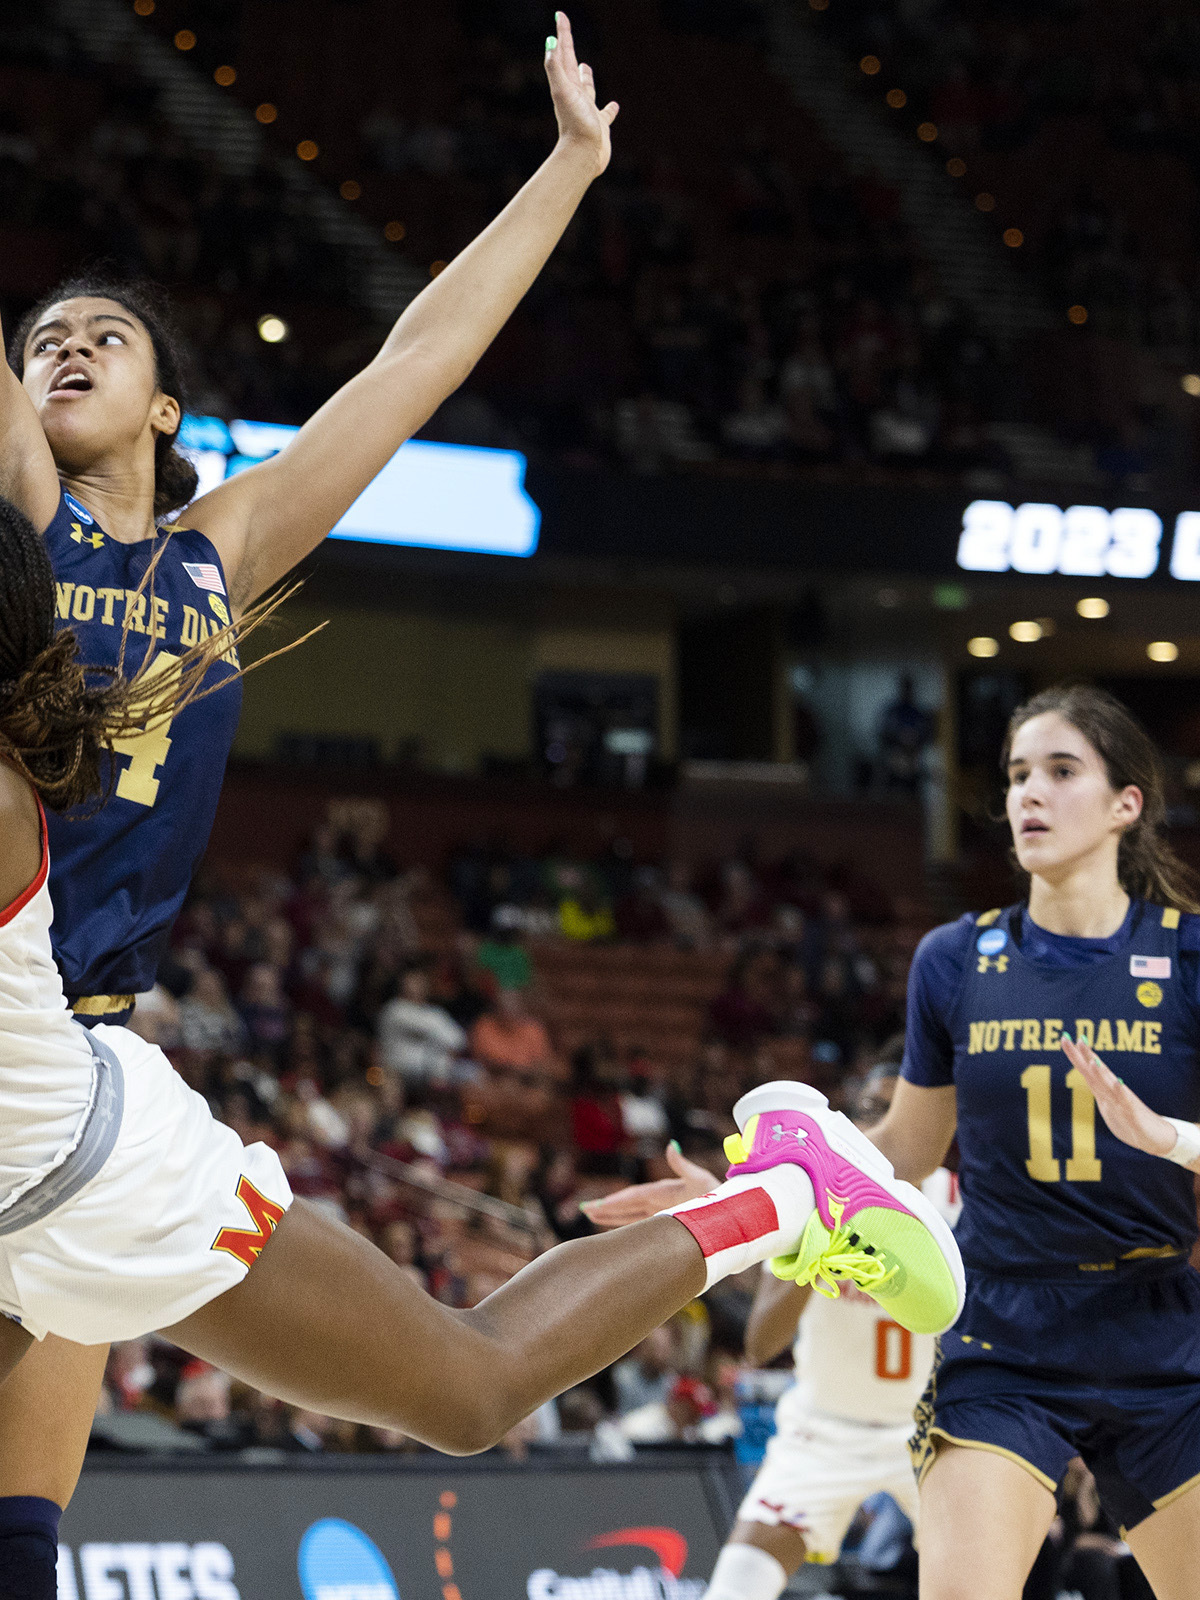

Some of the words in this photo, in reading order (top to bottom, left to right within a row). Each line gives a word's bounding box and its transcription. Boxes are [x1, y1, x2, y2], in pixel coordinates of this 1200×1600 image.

[956, 500, 1163, 579] 2023
[54, 582, 169, 639] NOTRE
[100, 651, 182, 808] 4
[967, 1018, 1063, 1055] NOTRE
[1075, 1018, 1162, 1055] DAME
[1020, 1064, 1102, 1183] 11
[875, 1318, 913, 1380] 0
